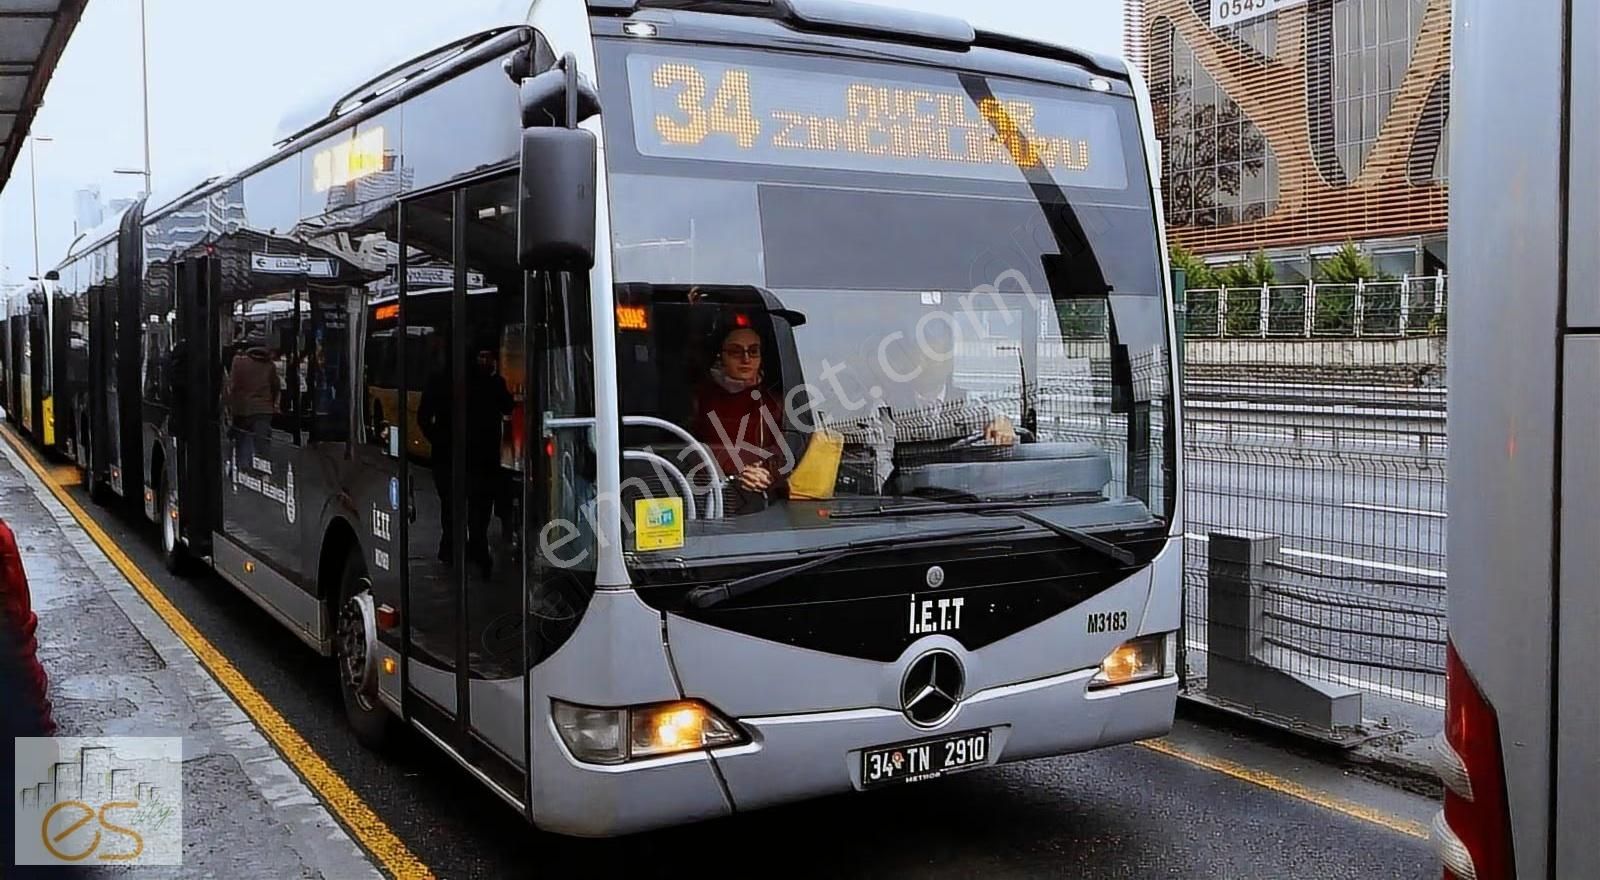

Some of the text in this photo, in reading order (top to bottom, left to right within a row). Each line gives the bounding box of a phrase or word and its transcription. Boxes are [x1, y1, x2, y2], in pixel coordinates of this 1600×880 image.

[651, 62, 761, 149] 34
[1087, 610, 1128, 634] M3183
[869, 736, 985, 780] 34 TN 2910
